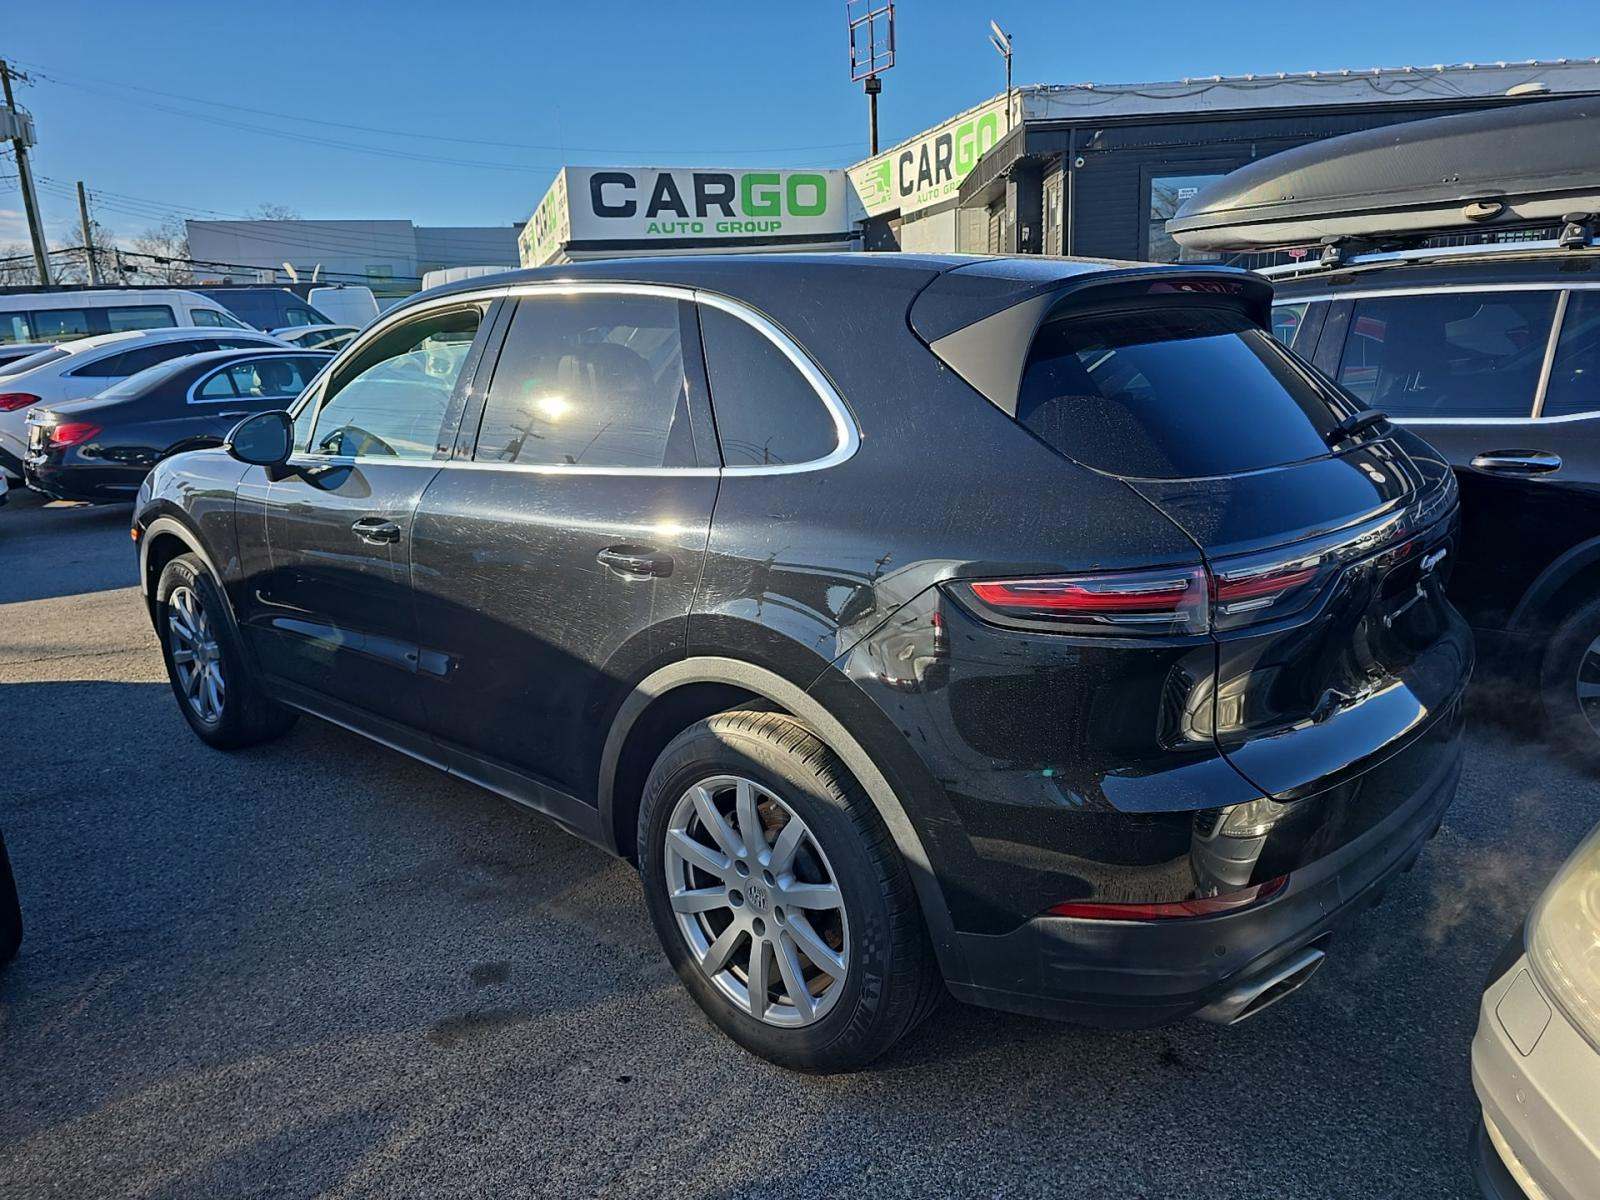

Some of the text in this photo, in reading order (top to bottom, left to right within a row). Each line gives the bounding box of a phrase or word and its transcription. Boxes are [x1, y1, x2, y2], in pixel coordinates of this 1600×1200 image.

[899, 112, 998, 197] CARGO
[589, 172, 827, 218] CARGO
[917, 188, 939, 204] AUTO
[646, 220, 782, 234] AUTO GROUP
